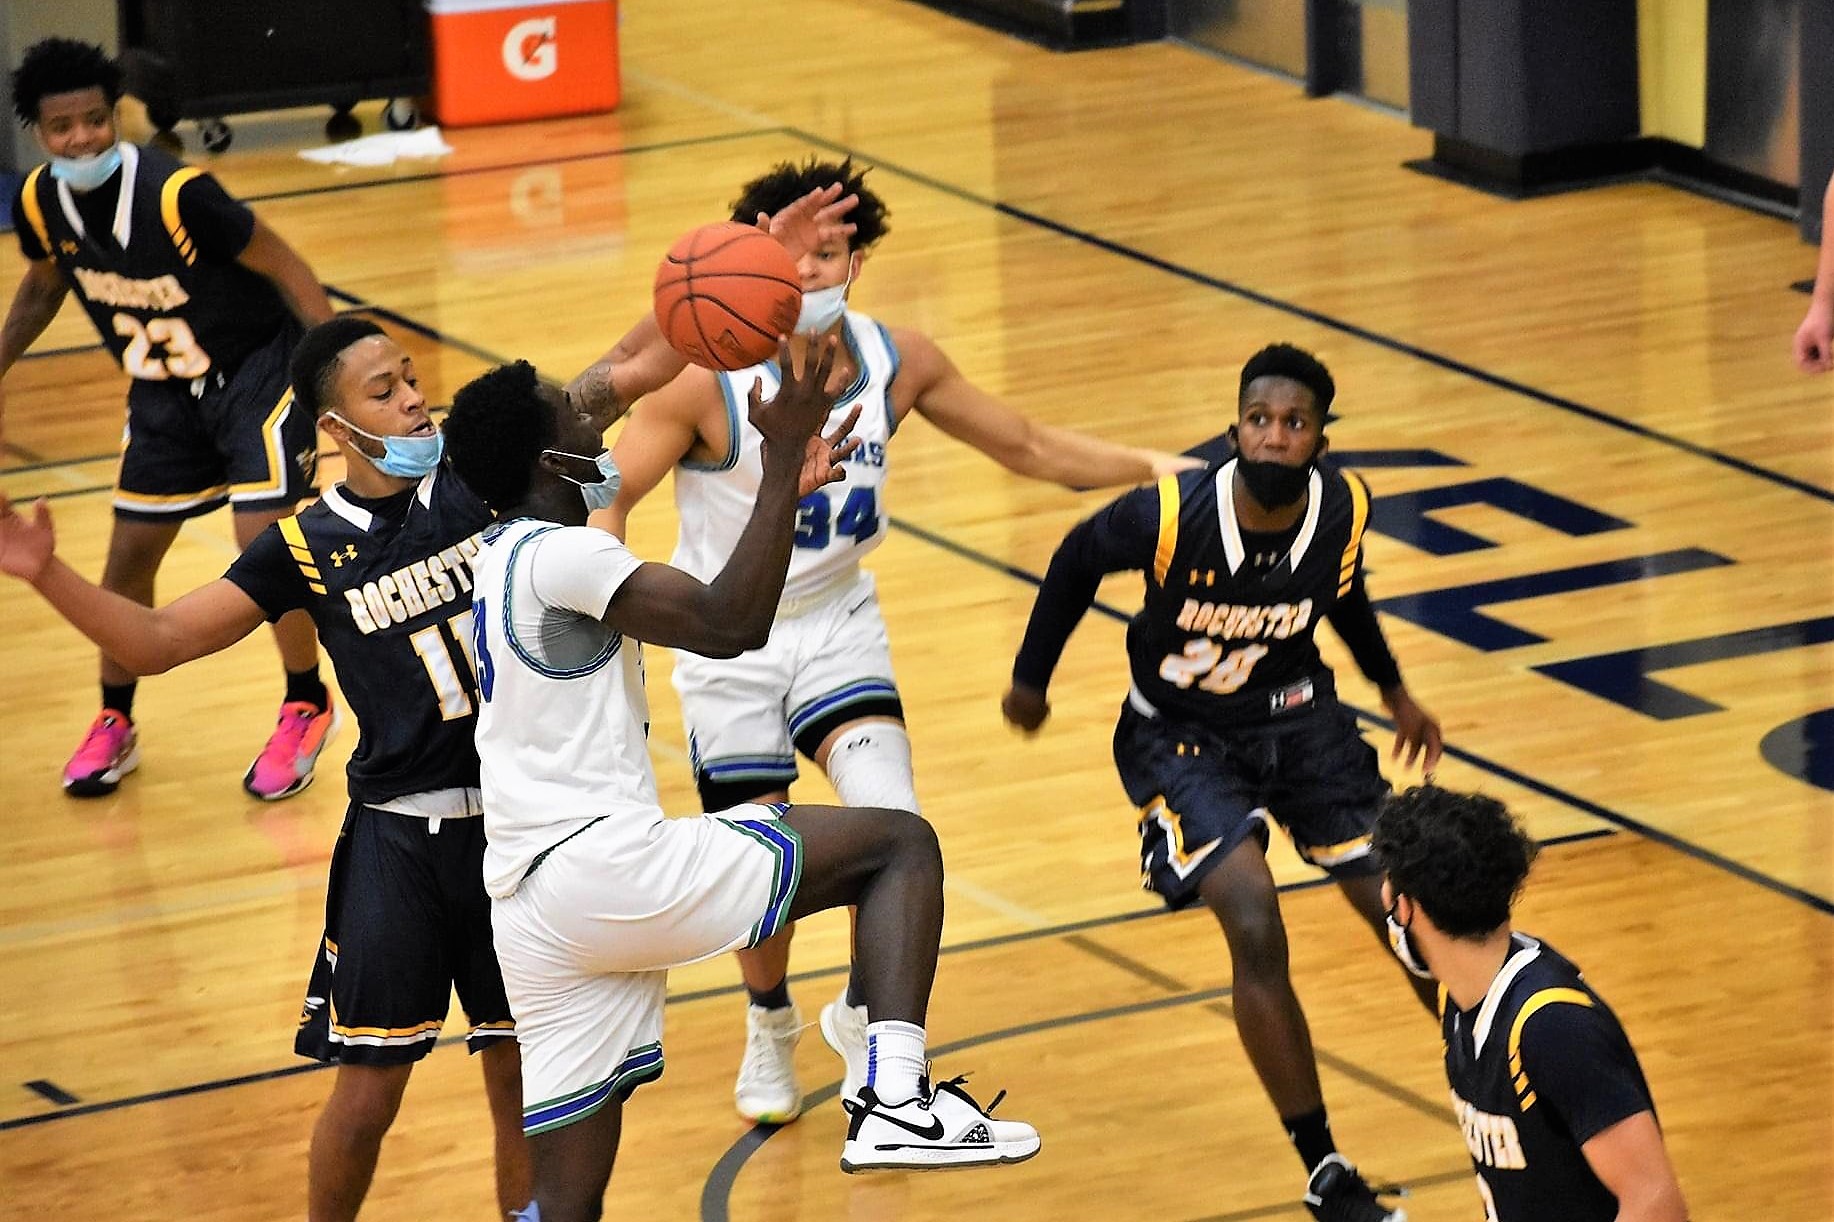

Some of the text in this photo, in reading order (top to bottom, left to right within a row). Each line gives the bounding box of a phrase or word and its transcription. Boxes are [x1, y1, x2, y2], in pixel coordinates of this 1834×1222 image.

[502, 16, 558, 82] G
[112, 312, 211, 380] 23
[794, 486, 880, 550] 34
[344, 531, 483, 635] ROCHEST
